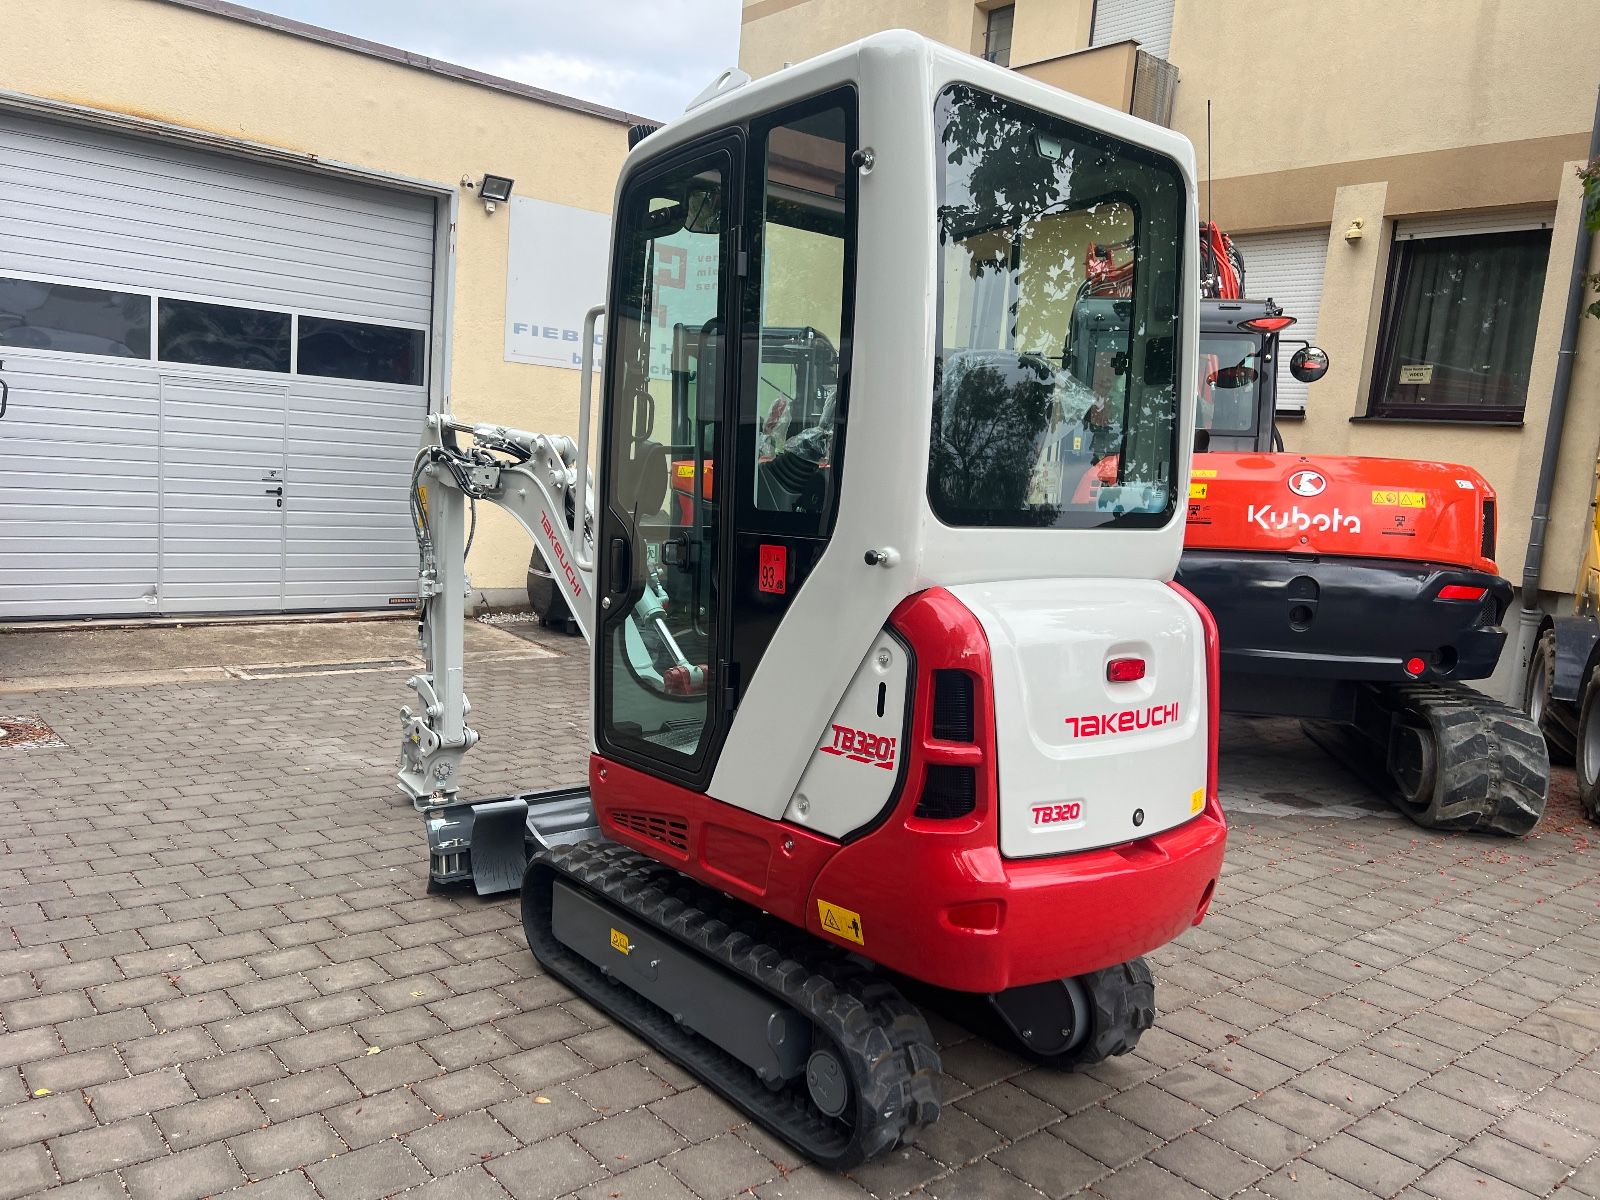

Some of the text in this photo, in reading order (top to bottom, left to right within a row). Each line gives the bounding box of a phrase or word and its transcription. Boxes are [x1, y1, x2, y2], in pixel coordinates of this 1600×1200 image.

[513, 322, 604, 345] FIEBG
[1247, 504, 1361, 534] Kubota
[762, 565, 775, 588] 93
[1031, 802, 1081, 825] TB320
